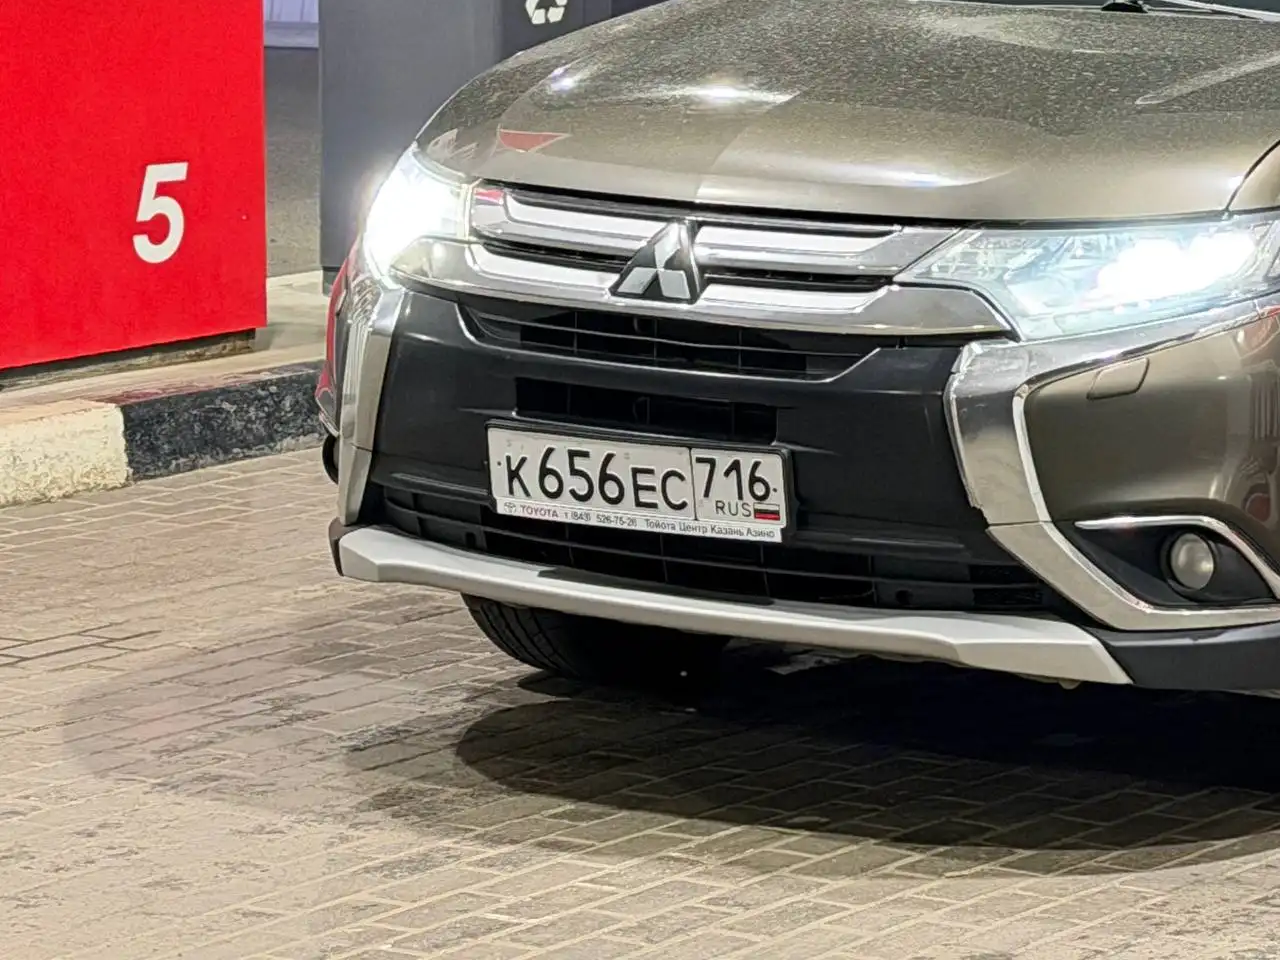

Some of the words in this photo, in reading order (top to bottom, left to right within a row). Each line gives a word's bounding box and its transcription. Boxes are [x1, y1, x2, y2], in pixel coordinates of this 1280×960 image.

[133, 162, 189, 264] 5
[695, 456, 771, 502] 716
[520, 504, 559, 518] TOYOTA
[644, 518, 676, 531] Тойота
[680, 522, 708, 534] Центр
[710, 524, 744, 537] Казань
[715, 500, 751, 517] RUS
